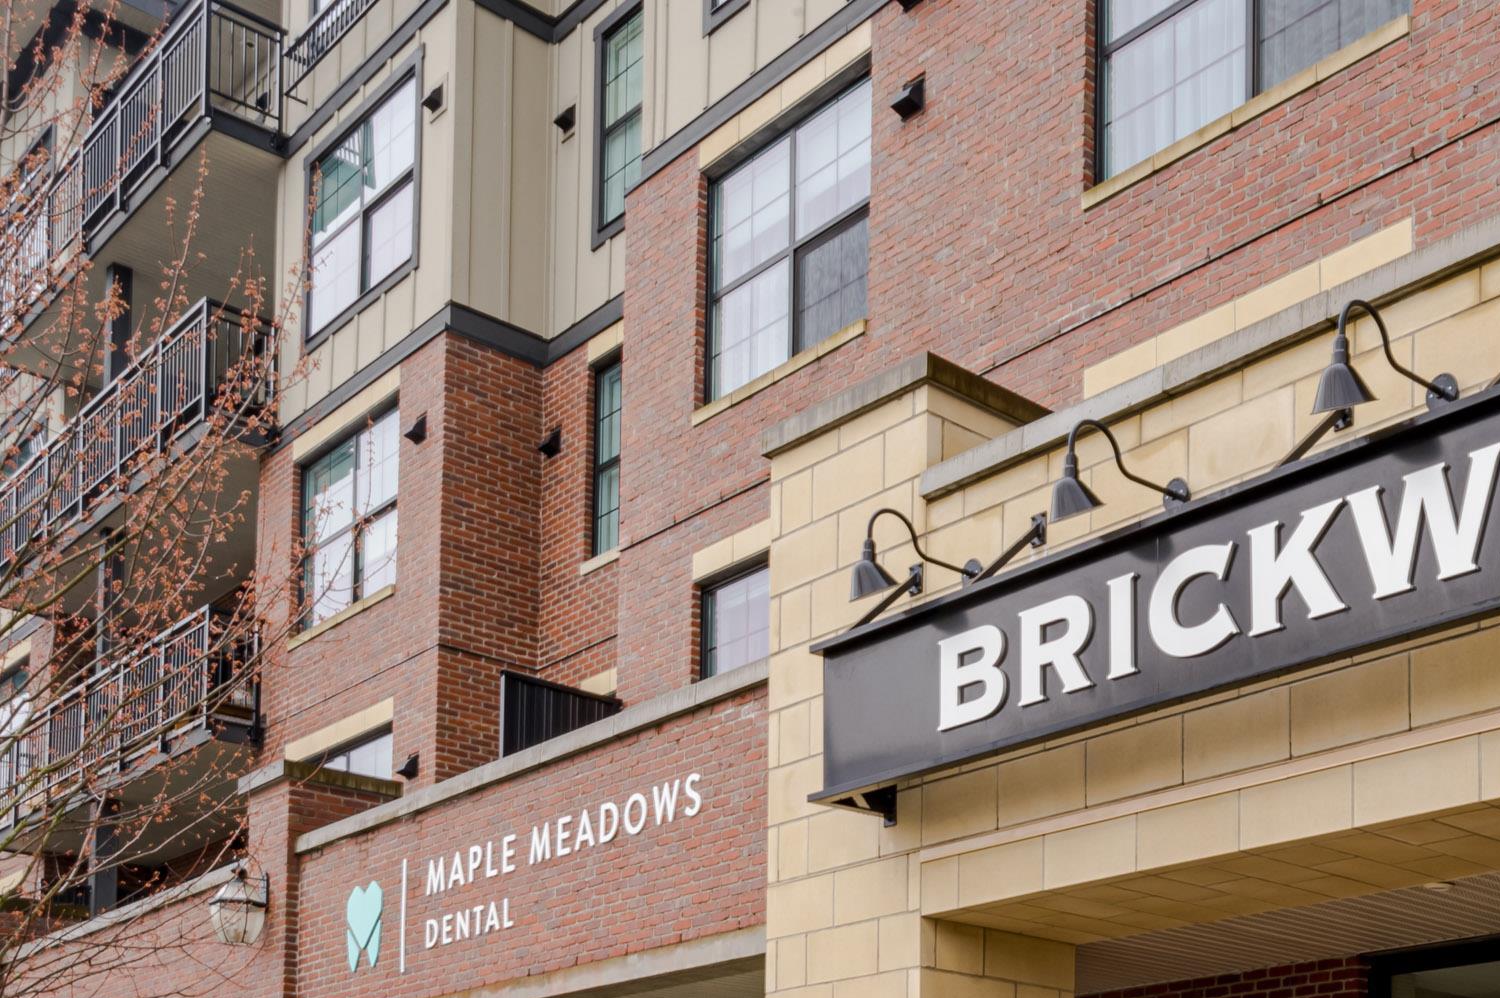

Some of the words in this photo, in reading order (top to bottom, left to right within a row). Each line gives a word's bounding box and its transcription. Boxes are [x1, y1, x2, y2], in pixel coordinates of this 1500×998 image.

[426, 834, 517, 896] MAPLE
[529, 773, 701, 865] MEADOWS
[426, 898, 514, 949] DENTAL
